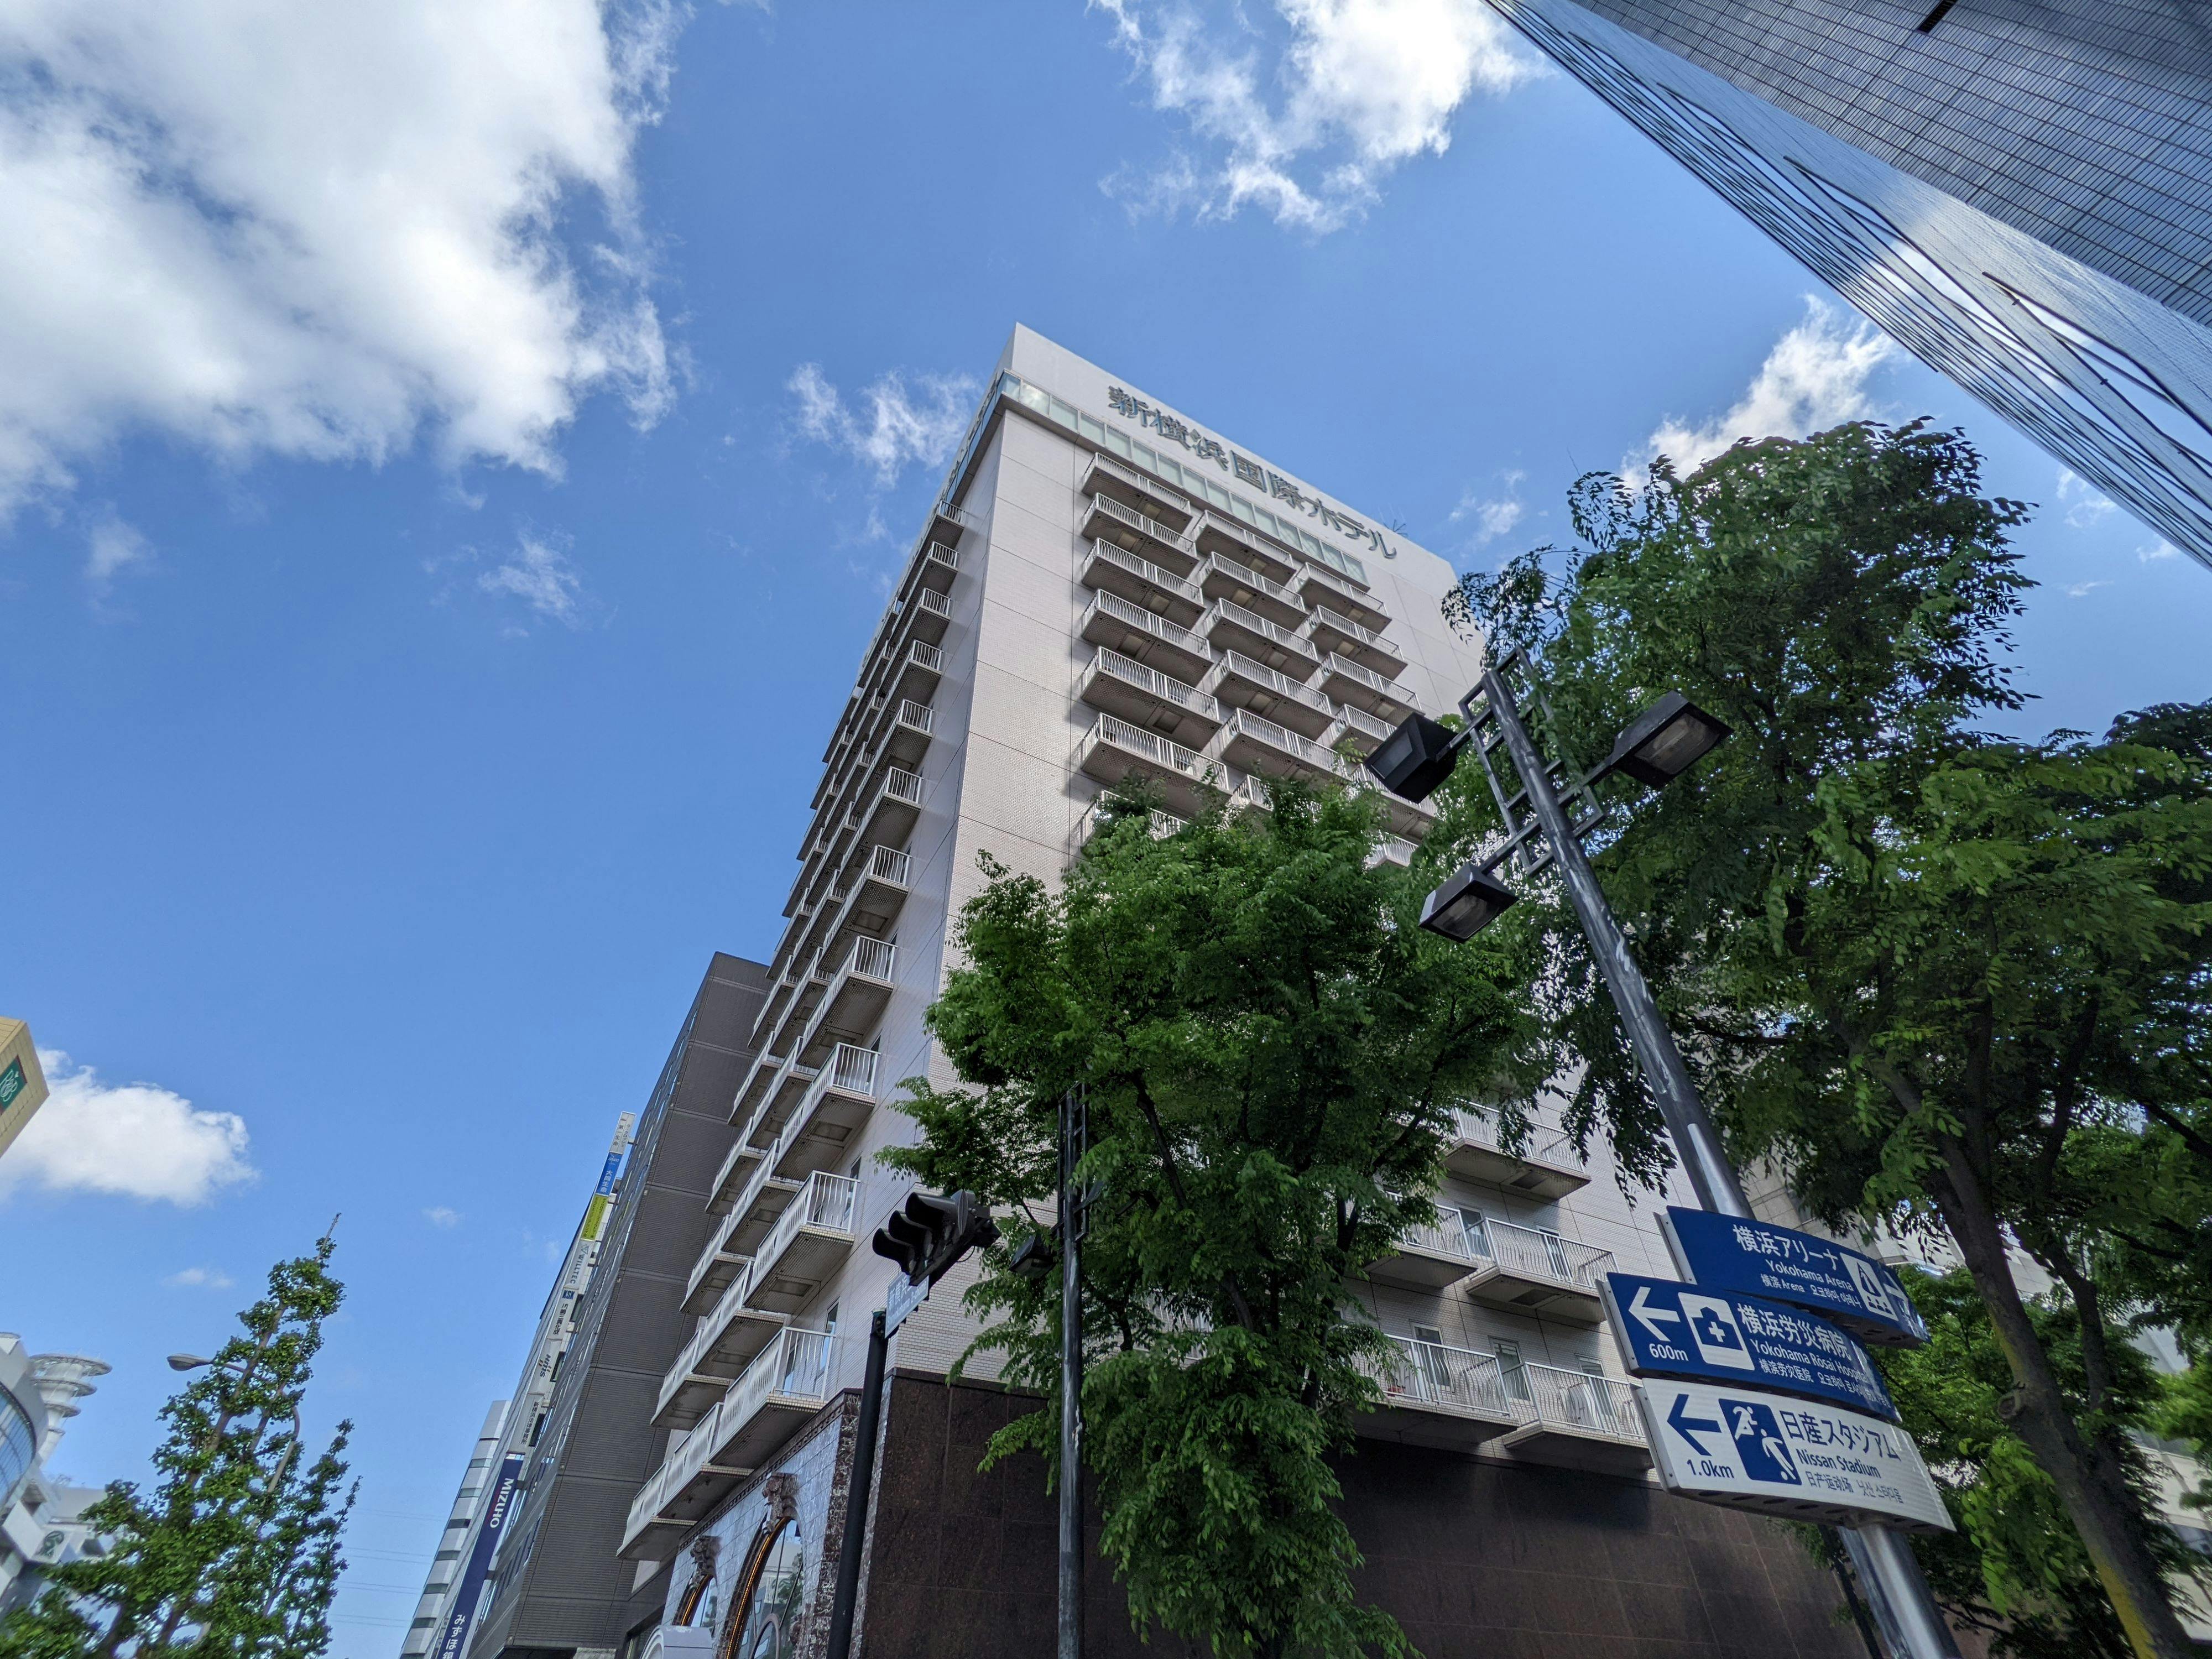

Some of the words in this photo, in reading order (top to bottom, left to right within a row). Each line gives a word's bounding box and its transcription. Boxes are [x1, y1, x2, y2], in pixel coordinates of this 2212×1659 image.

[1108, 385, 1397, 559] 新横浜国際ホテル
[613, 1124, 624, 1146] 第一生命
[600, 1170, 613, 1193] 大同生命
[1733, 1224, 1838, 1270] 横浜アリーナ
[570, 1254, 585, 1284] WILLTEC
[1765, 1259, 1825, 1283] Yokohama
[1826, 1274, 1854, 1292] Arena
[562, 1290, 576, 1300] KSK
[1783, 1281, 1805, 1293] Arena
[1810, 1285, 1840, 1302] 요코하마
[1738, 1303, 1851, 1361] 横浜労災病院
[1649, 1343, 1689, 1361] 600m
[1750, 1338, 1811, 1364] Yokohama
[1817, 1371, 1846, 1392] 요코하마
[1780, 1410, 1901, 1461] 日産スタジアム
[1687, 1459, 1734, 1479] 1.0km
[1796, 1448, 1838, 1469] Nissan
[1837, 1455, 1881, 1478] Stadium
[1805, 1471, 1854, 1493] 日产运动场
[1856, 1480, 1876, 1498] 닛산
[1876, 1484, 1904, 1504] 스타디움
[490, 1478, 514, 1528] MIZUHO
